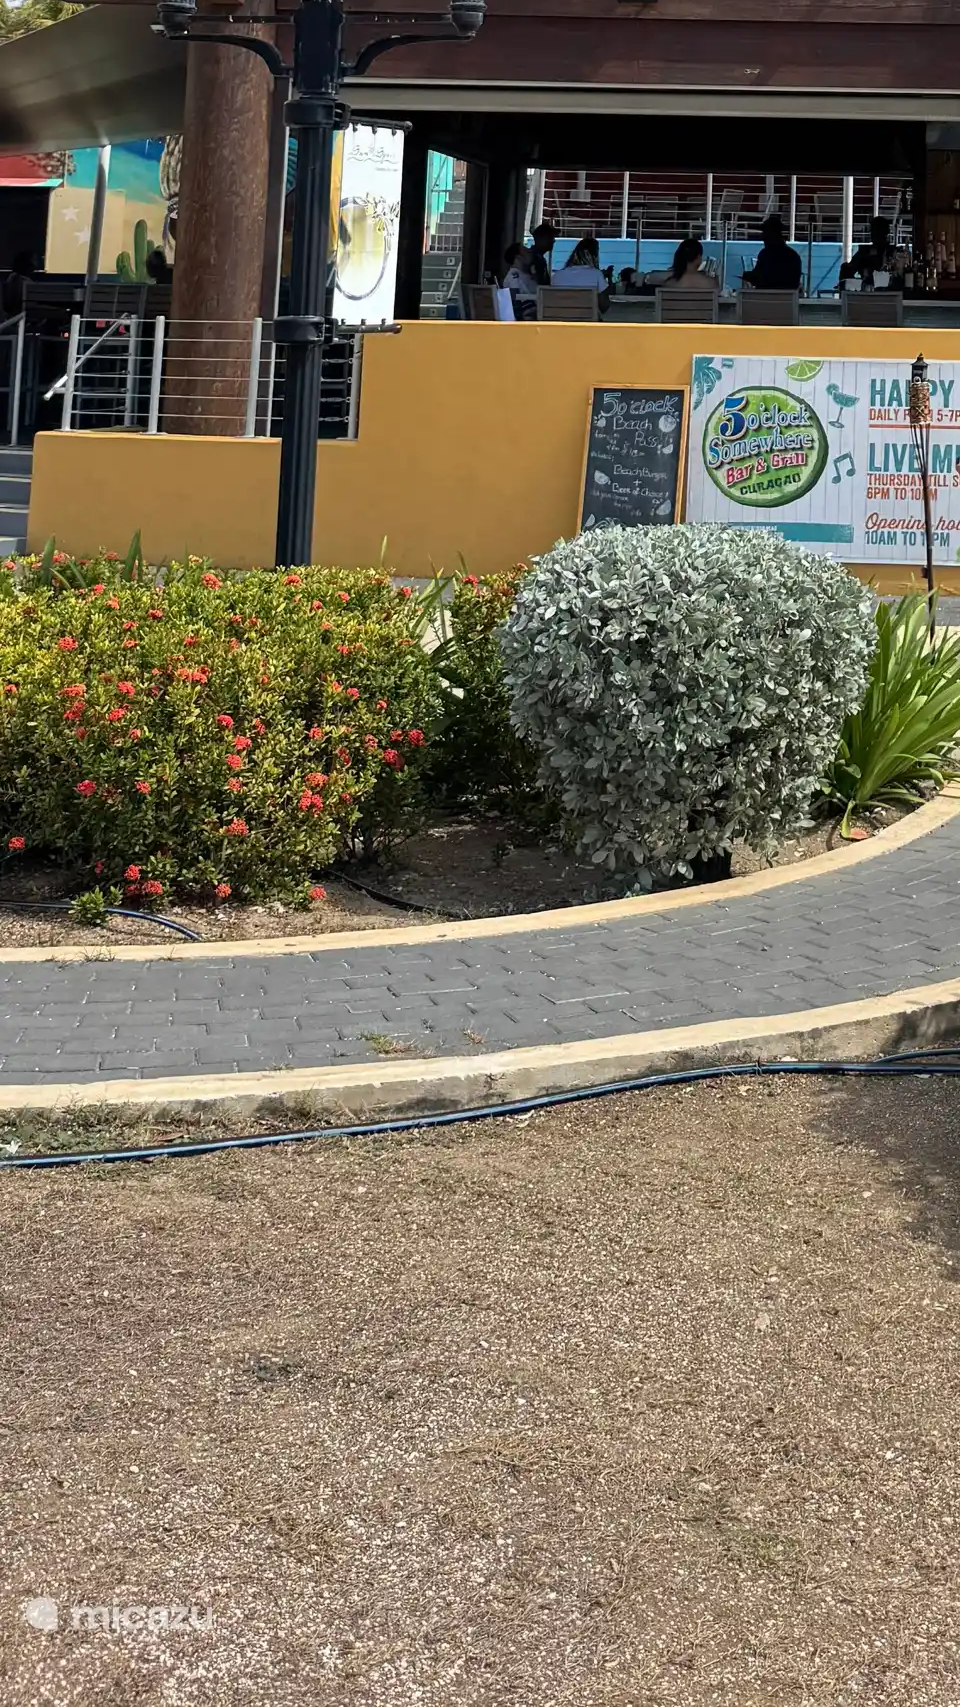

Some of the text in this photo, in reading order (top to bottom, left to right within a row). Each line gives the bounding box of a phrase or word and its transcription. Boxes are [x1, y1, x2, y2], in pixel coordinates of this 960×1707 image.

[613, 415, 652, 430] Beach
[869, 408, 900, 421] DAILY
[708, 427, 813, 468] Somewhere
[869, 443, 921, 472] LIVE
[726, 452, 806, 487] Bar & Grill
[866, 487, 938, 501] 6PM TO 10M
[865, 512, 929, 531] Openin
[865, 531, 950, 547] 10AM TO 1PM
